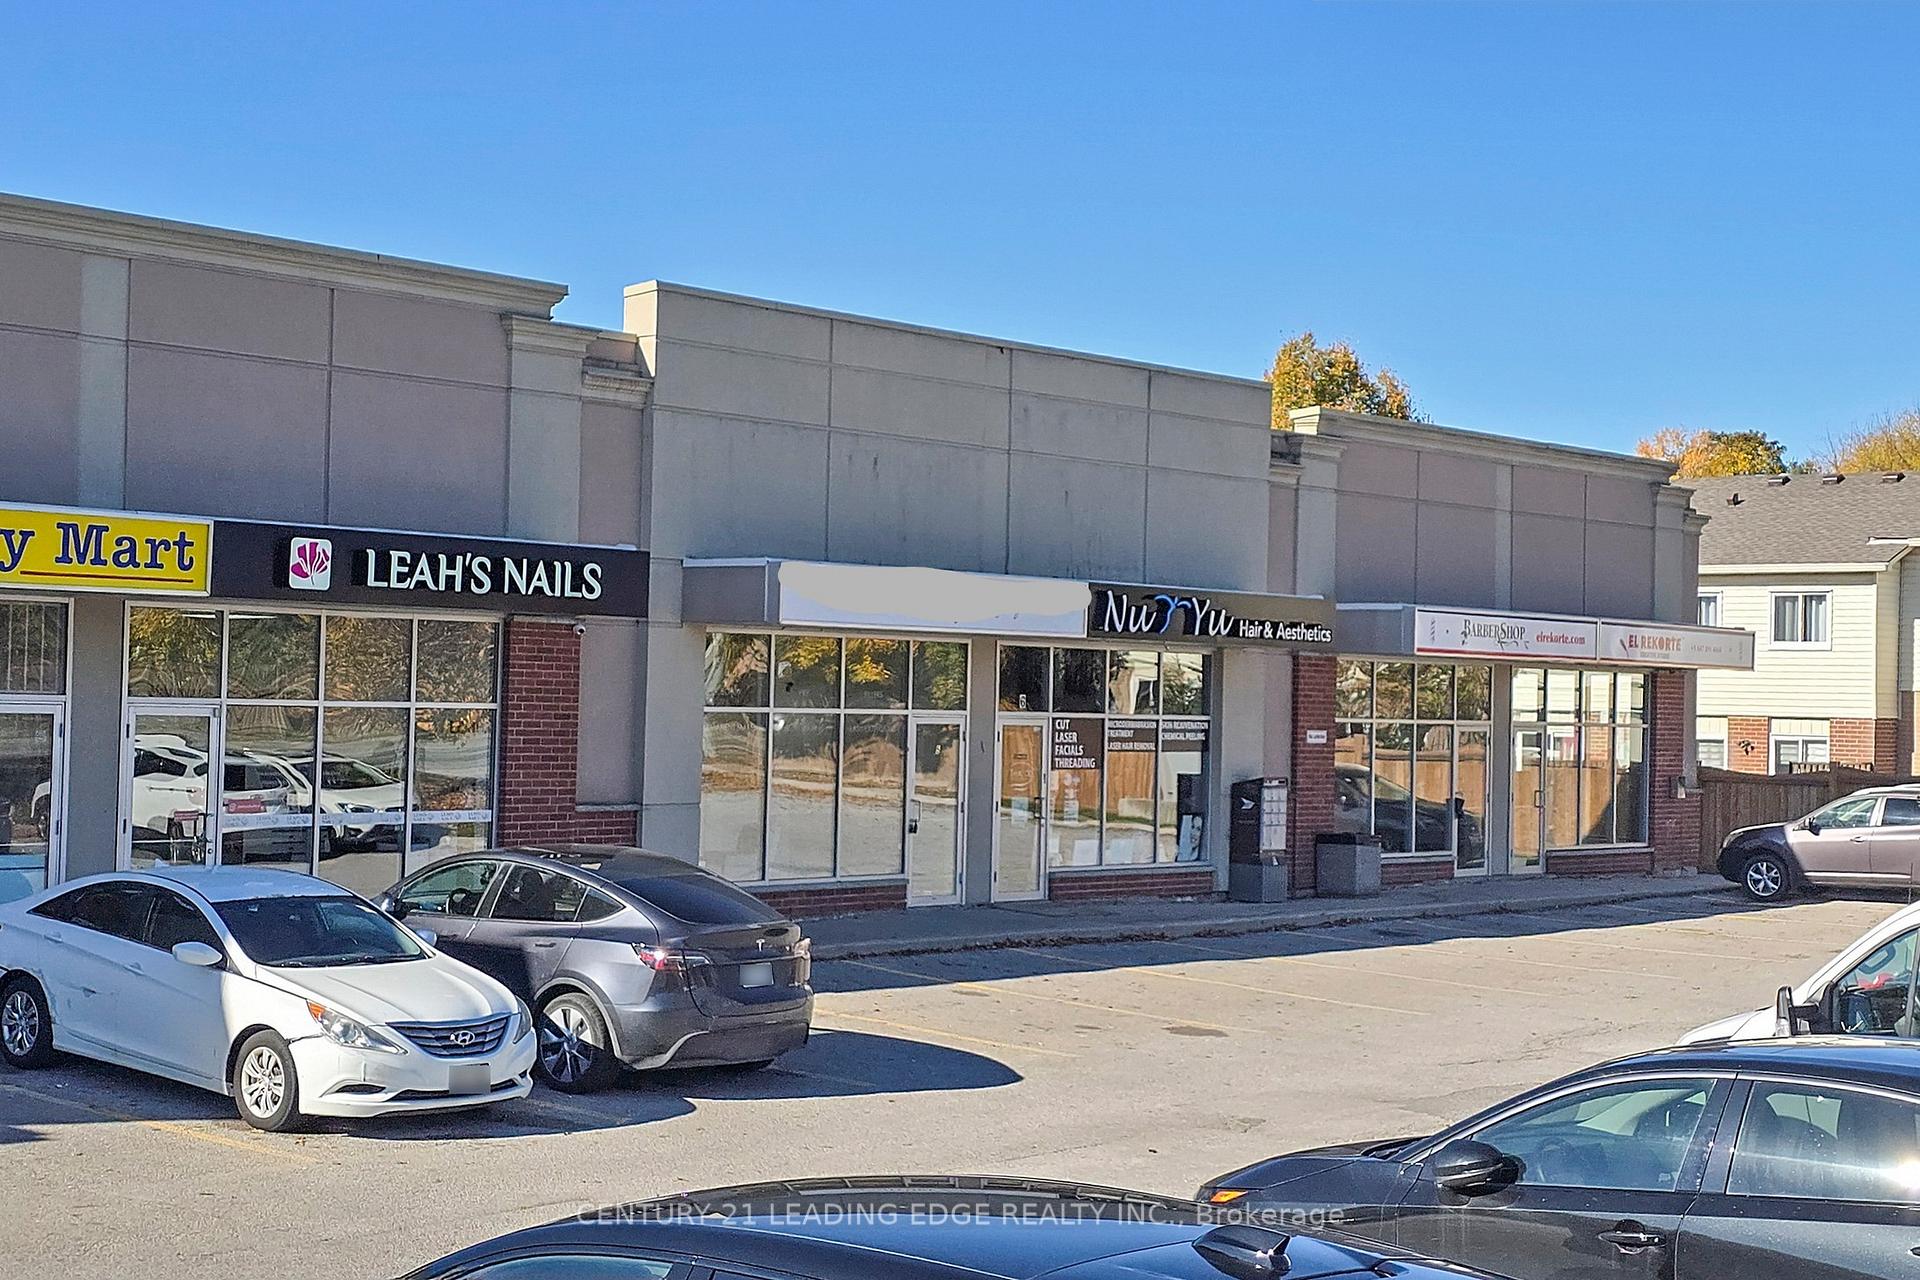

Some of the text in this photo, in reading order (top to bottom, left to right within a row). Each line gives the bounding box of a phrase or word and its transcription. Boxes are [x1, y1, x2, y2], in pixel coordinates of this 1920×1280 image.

[55, 522, 195, 572] Mart
[365, 548, 603, 600] LEAH'S NAILS
[1103, 589, 1158, 633] Nu
[1191, 596, 1236, 637] Yu
[1275, 622, 1333, 643] Aesthetics
[1535, 630, 1587, 646] elrekorte.com
[1627, 633, 1640, 650] EL
[1640, 634, 1683, 652] REKORTE
[1055, 719, 1071, 730] CUT
[1055, 732, 1078, 743] LASER
[1055, 744, 1084, 756] FACIALS
[1055, 757, 1096, 769] THREADING
